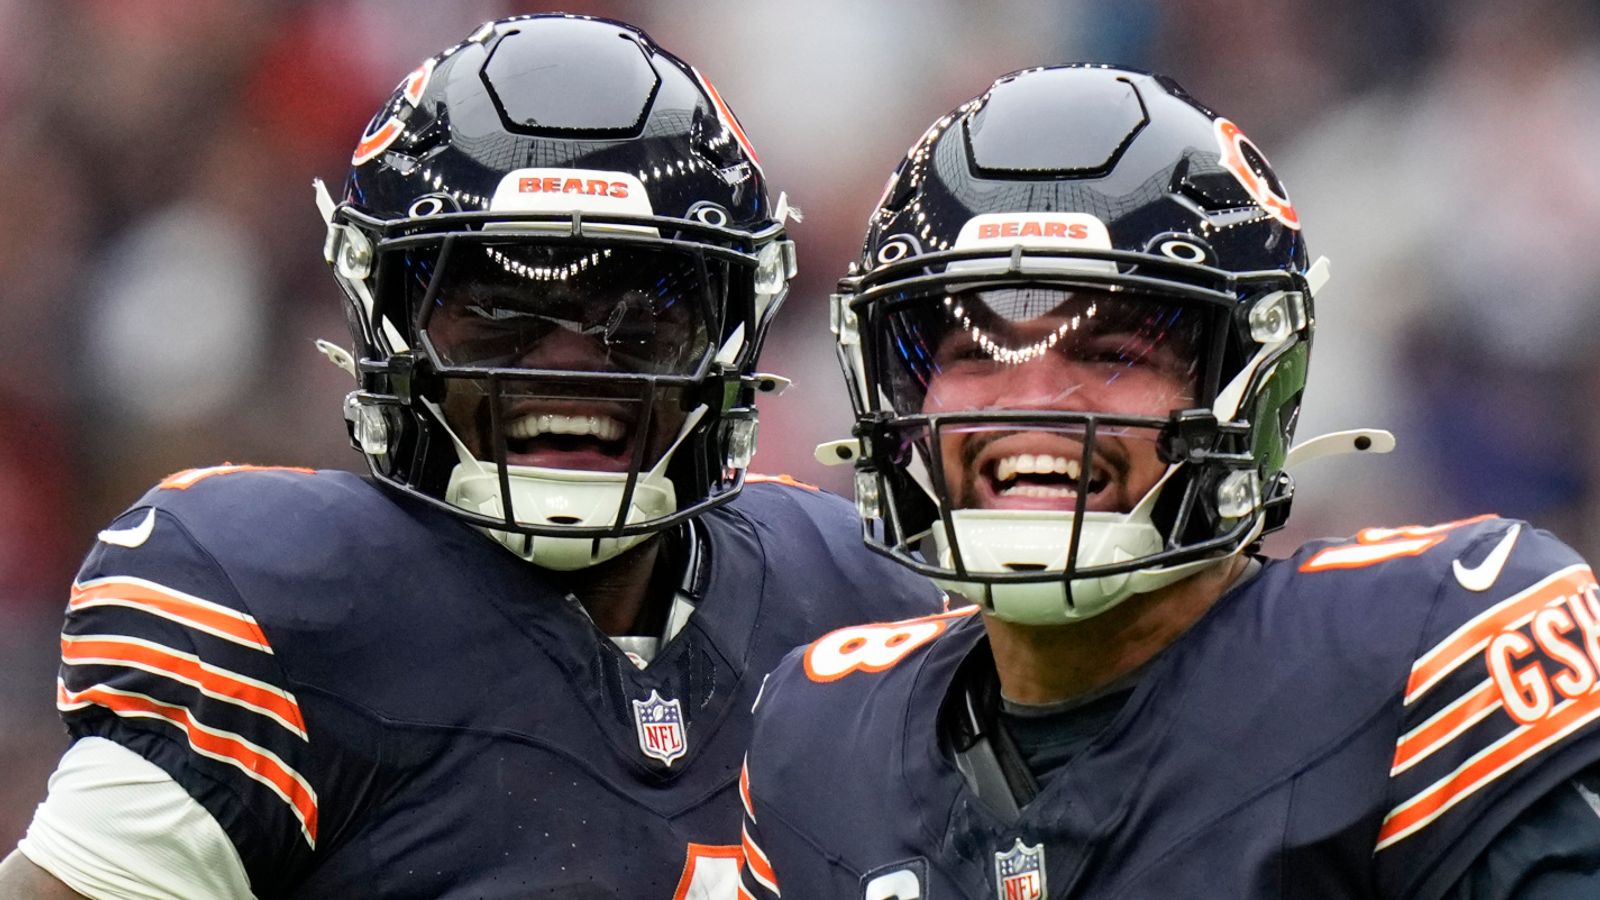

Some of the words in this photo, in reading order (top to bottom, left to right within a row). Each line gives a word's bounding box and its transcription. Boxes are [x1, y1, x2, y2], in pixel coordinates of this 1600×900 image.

[518, 177, 629, 199] BEARS
[978, 221, 1089, 240] BEARS
[803, 604, 981, 684] 8
[645, 725, 681, 752] NFL
[1003, 874, 1039, 900] NFL
